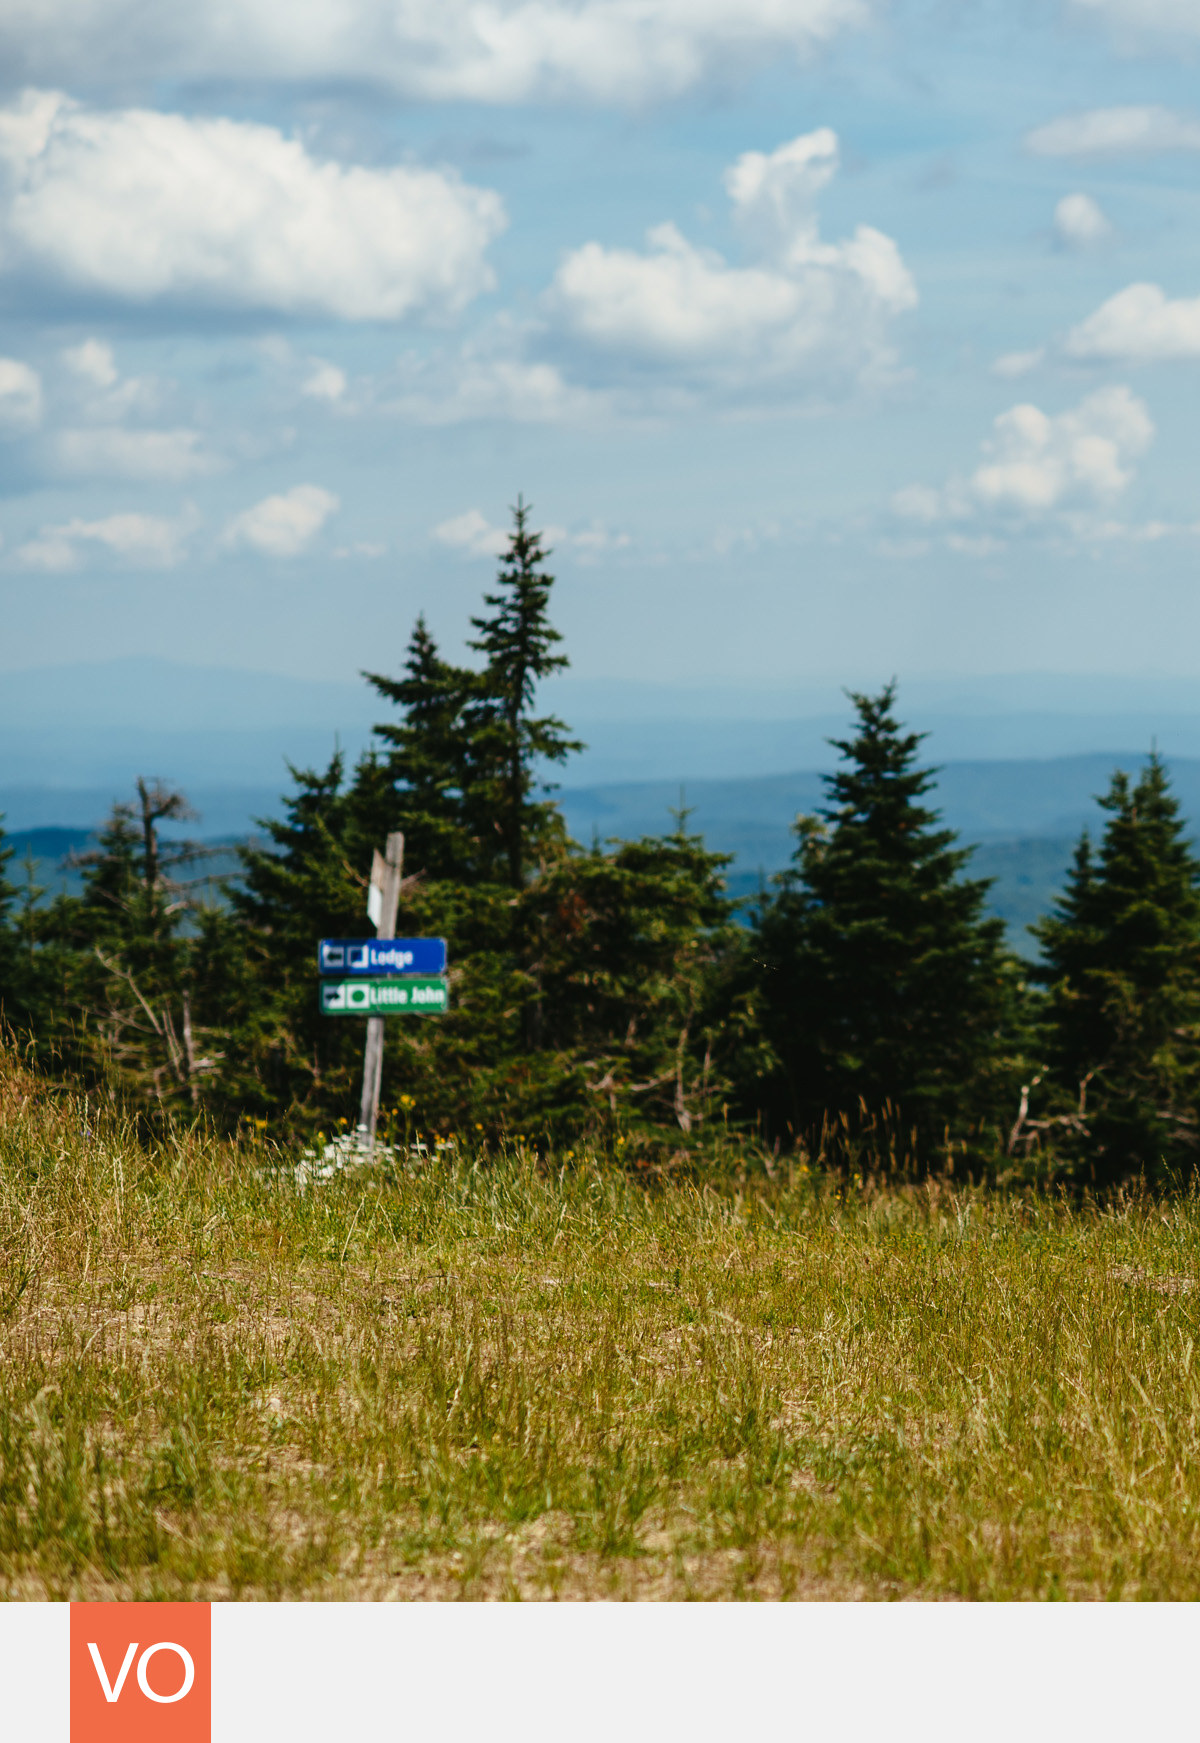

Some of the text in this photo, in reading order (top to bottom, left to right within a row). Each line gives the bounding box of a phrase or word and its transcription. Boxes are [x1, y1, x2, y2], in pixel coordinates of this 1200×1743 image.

[371, 949, 413, 969] Lodge
[371, 986, 445, 1005] Little John
